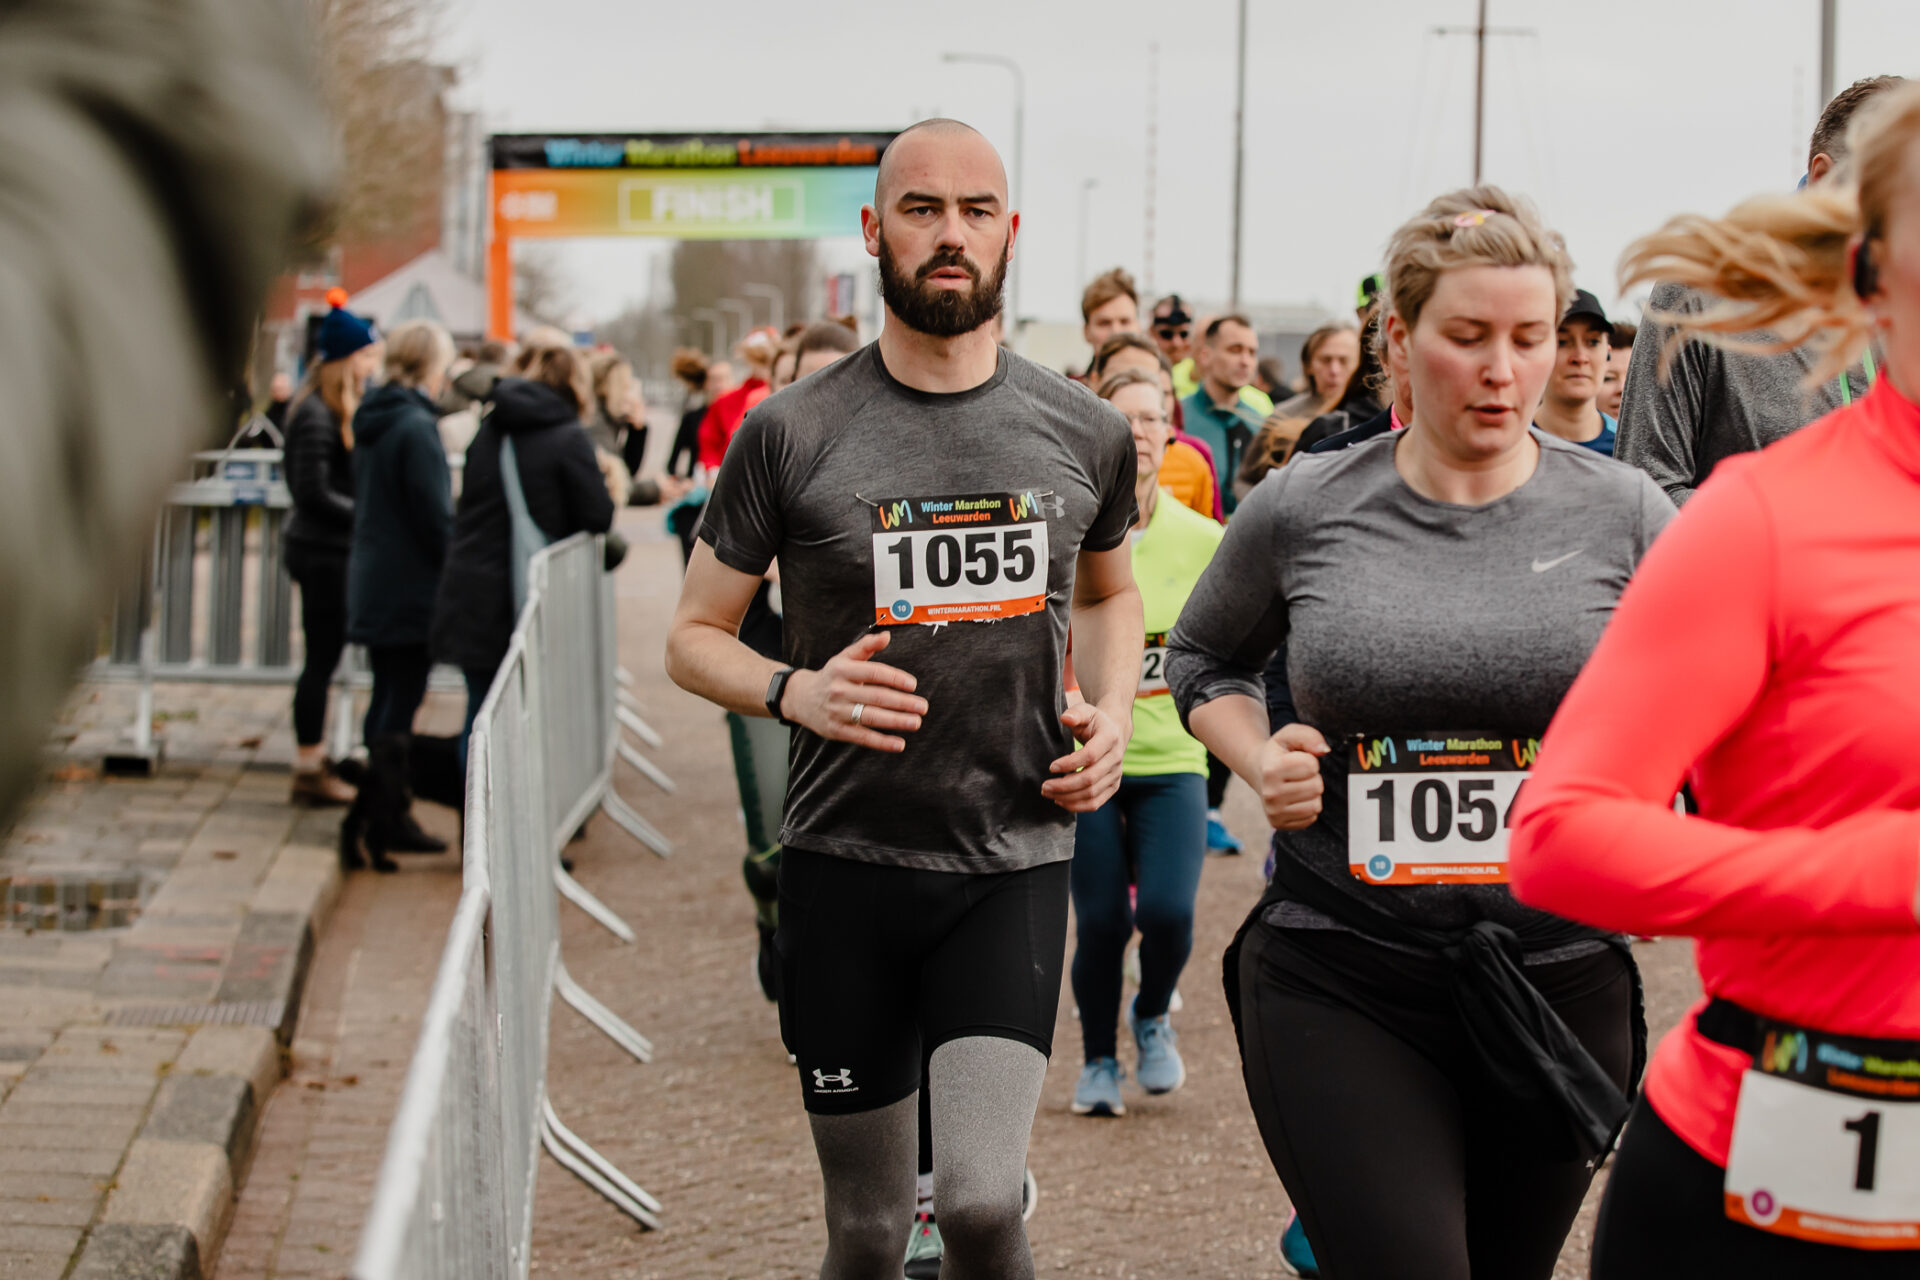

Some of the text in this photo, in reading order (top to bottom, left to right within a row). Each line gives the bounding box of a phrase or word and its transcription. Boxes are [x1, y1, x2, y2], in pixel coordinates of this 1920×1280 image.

[652, 184, 774, 222] FINISH
[921, 498, 1001, 513] Winter Marathon
[932, 511, 991, 524] Leeuwarden
[888, 529, 1035, 589] 1055
[927, 604, 1002, 615] WINTERMARATHON.FRL
[1406, 738, 1502, 751] Winter Marathon
[1419, 753, 1490, 766] Leeuwarden
[1845, 1112, 1880, 1190] 1
